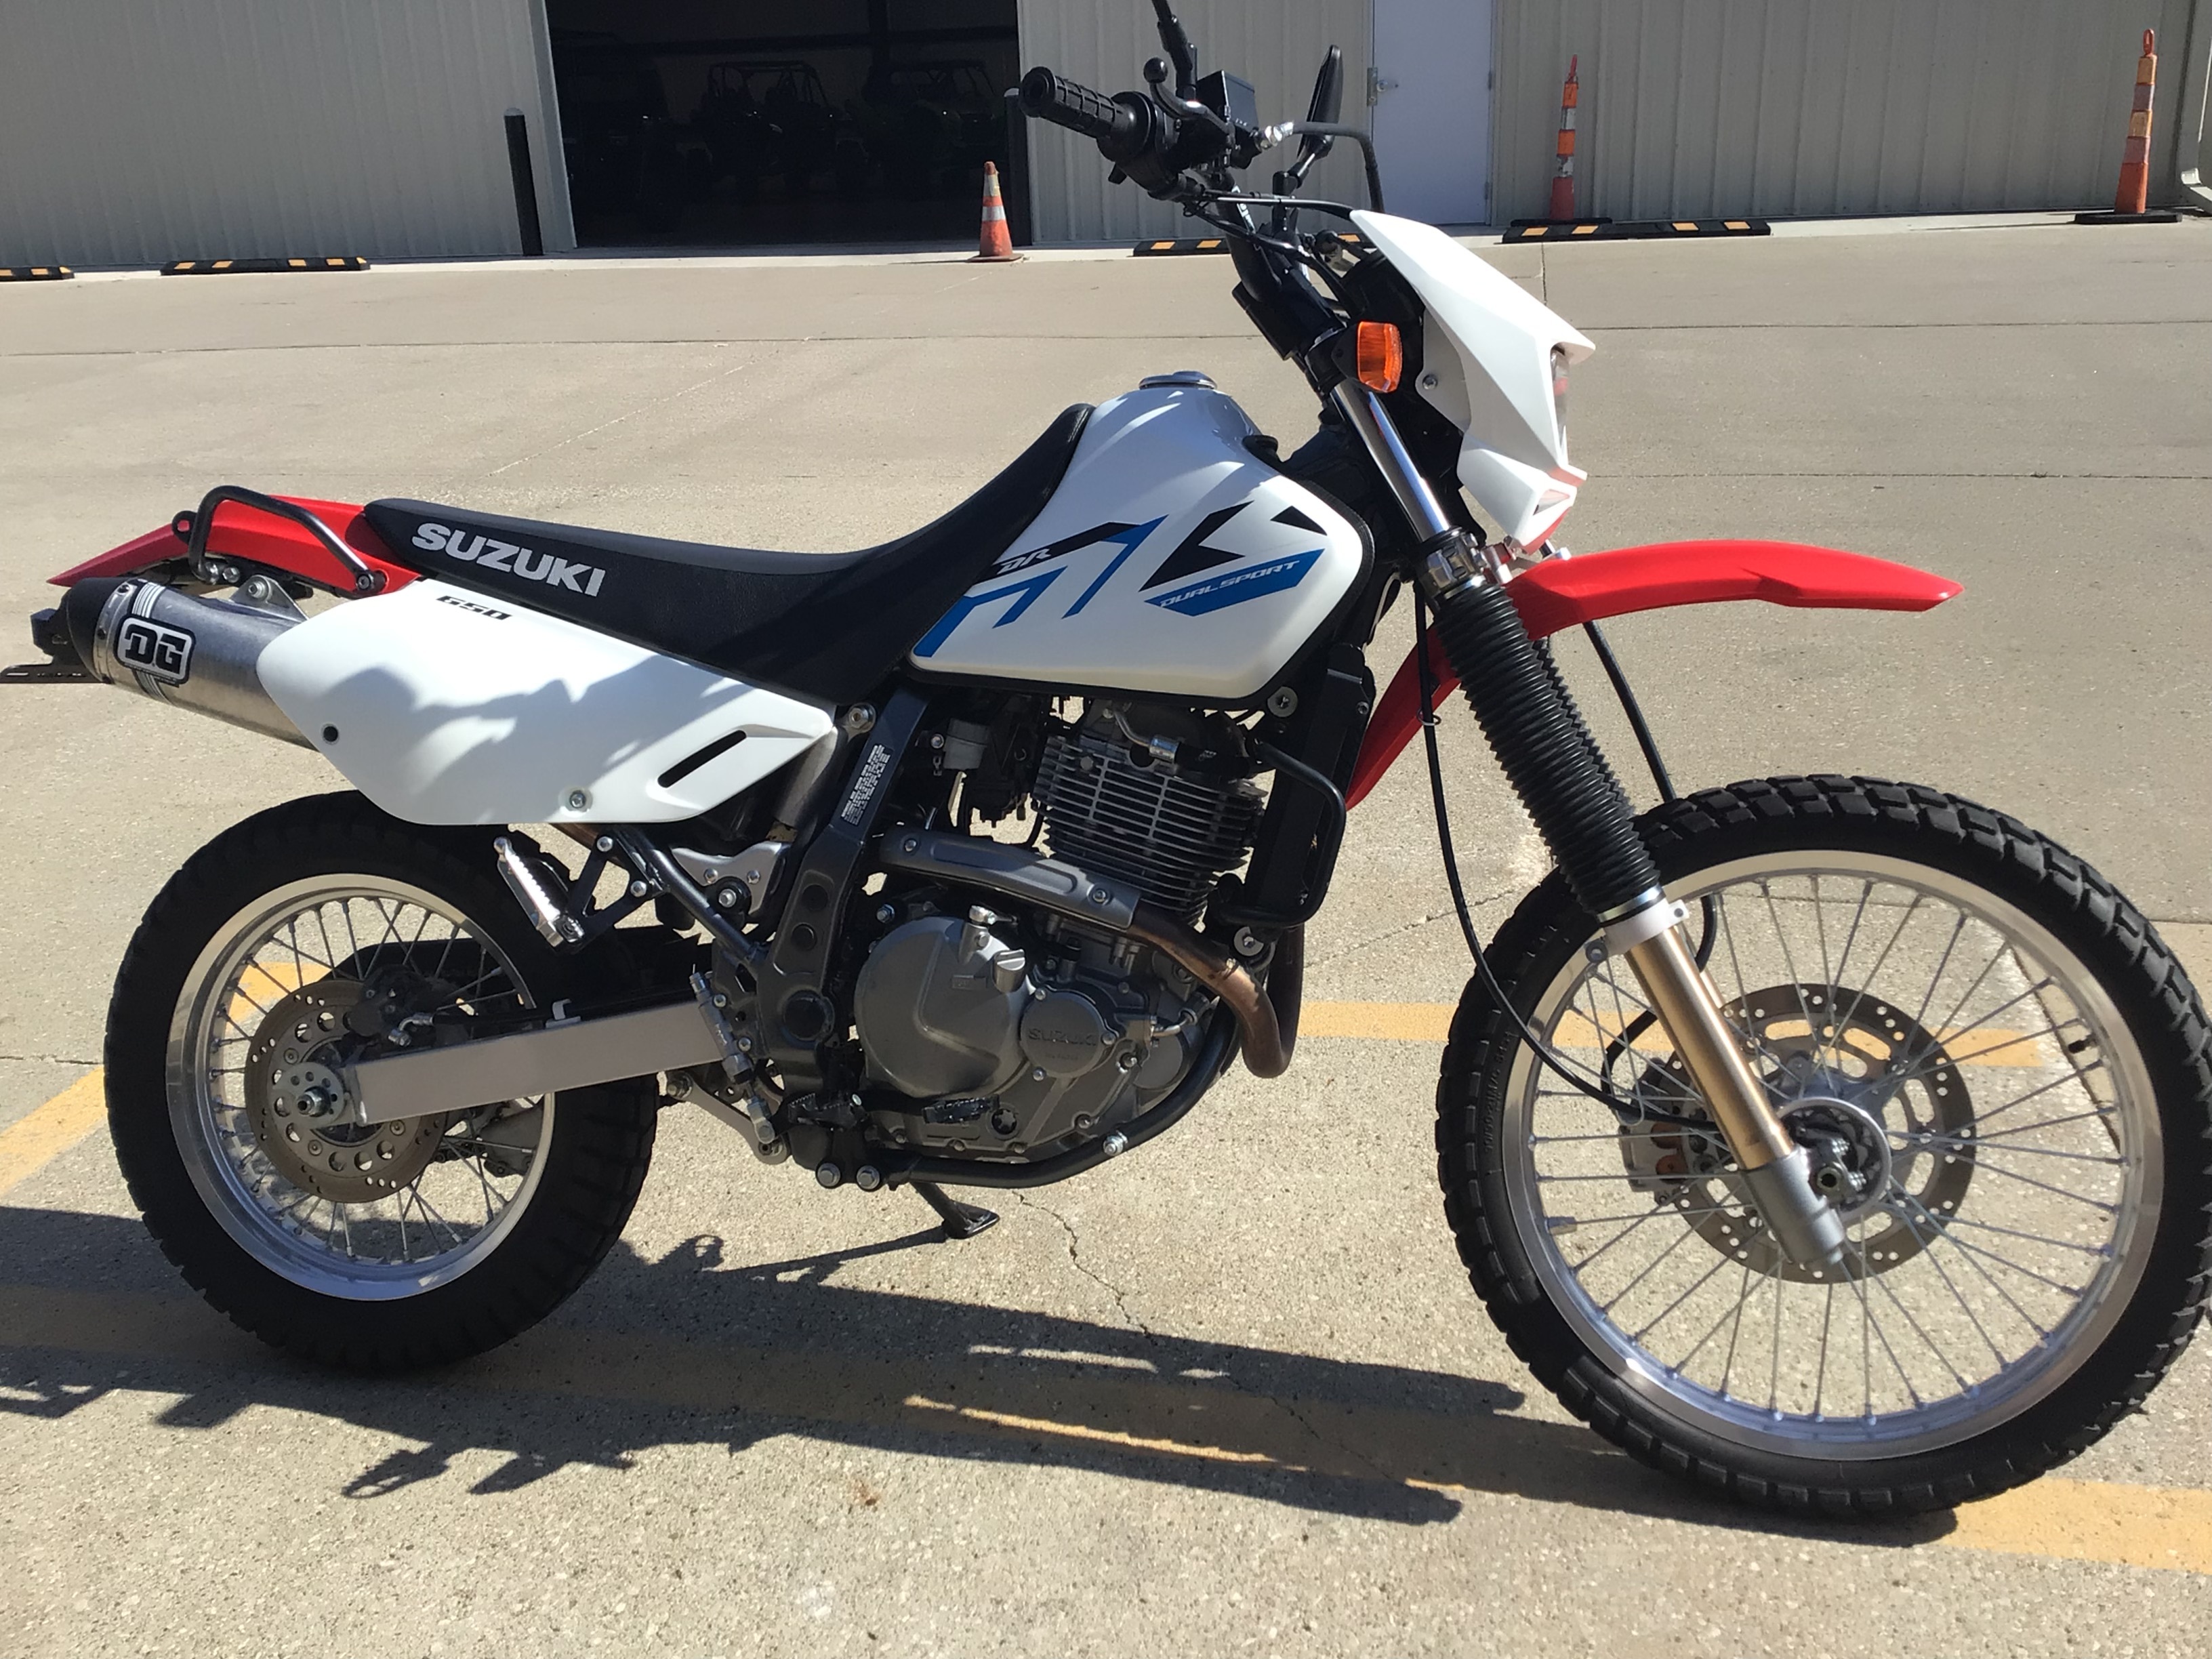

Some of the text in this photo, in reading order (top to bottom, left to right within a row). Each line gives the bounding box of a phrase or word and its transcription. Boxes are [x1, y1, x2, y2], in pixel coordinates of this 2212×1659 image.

[412, 523, 606, 597] SUZUKI
[996, 548, 1052, 575] DR
[436, 595, 513, 620] 650
[124, 623, 187, 674] DG
